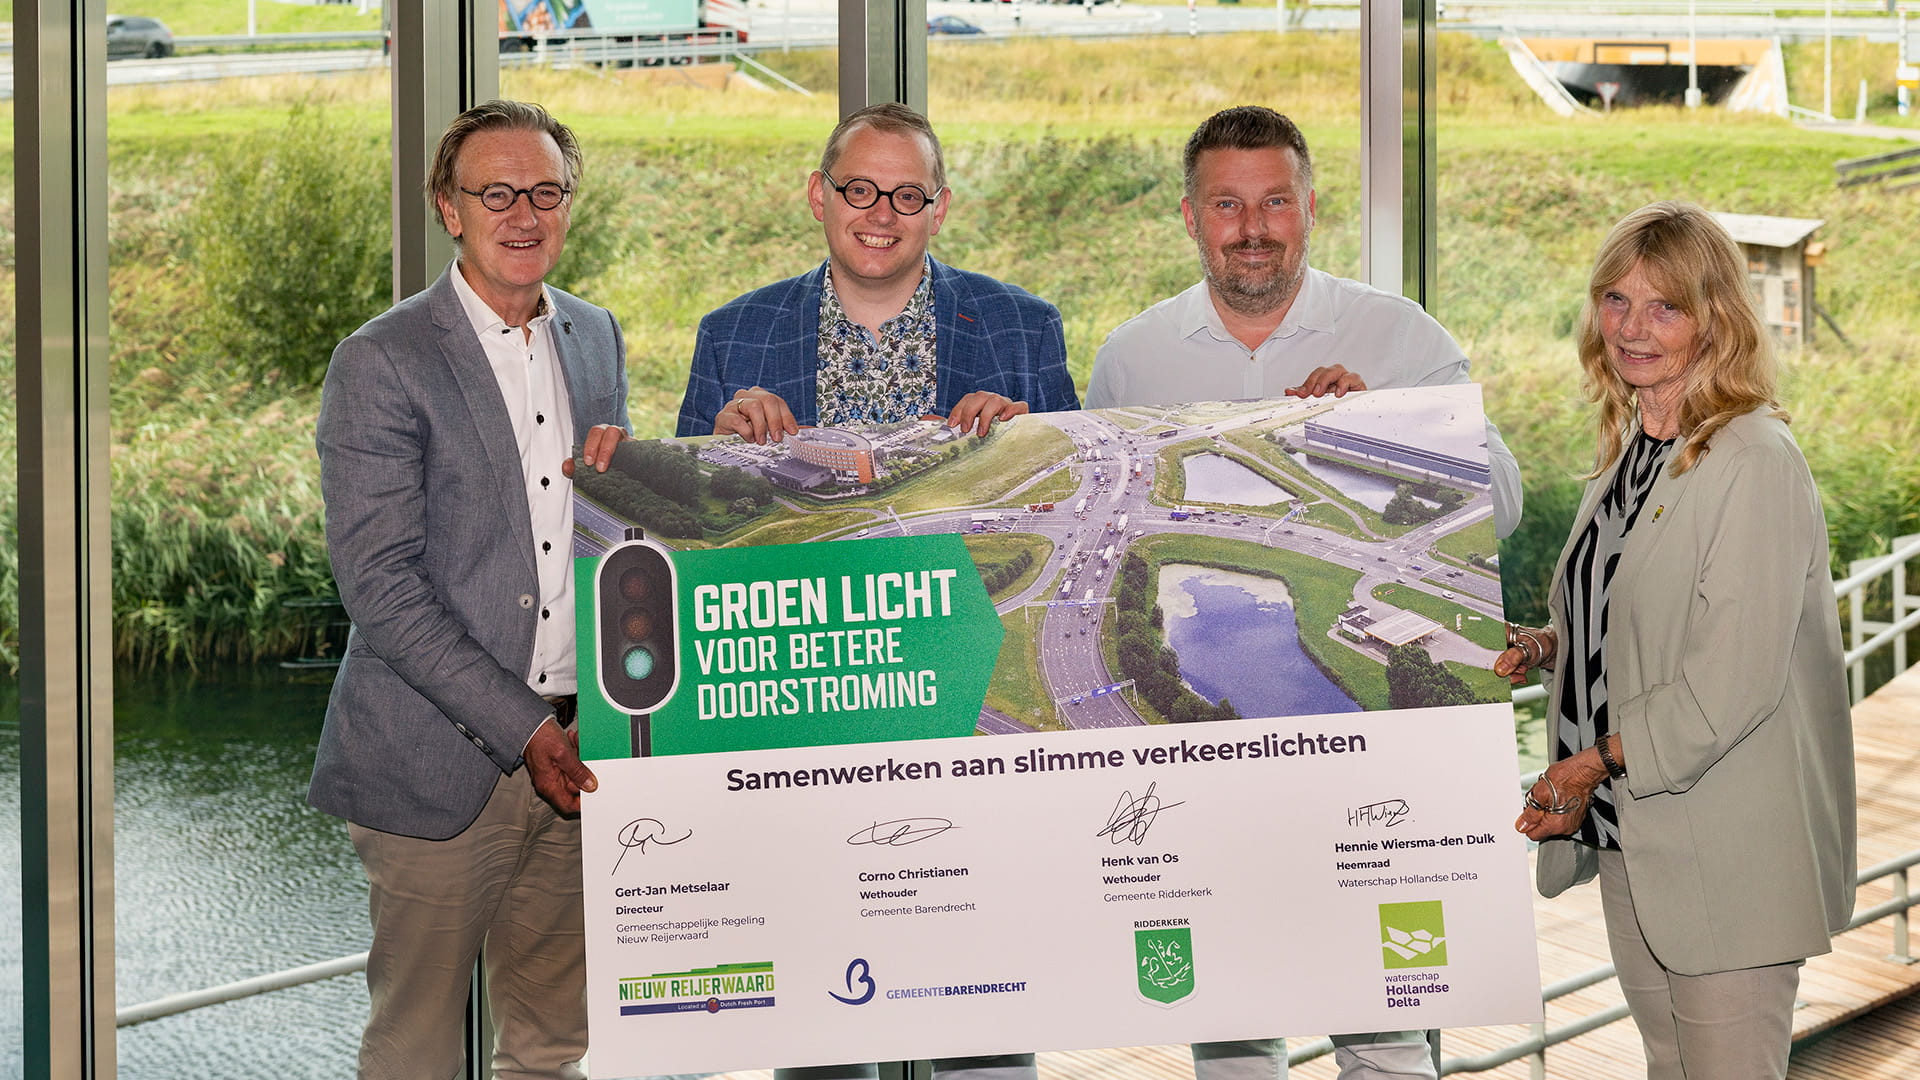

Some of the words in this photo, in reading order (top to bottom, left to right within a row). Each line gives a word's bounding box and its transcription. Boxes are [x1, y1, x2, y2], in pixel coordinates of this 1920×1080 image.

[694, 577, 828, 631] GROEN
[841, 569, 957, 622] LICHT
[694, 635, 777, 674] VOOR
[789, 627, 903, 669] BETERE
[698, 670, 936, 720] DOORSTROMING
[726, 757, 942, 792] Samenwerken
[952, 755, 1005, 777] aan
[1014, 748, 1124, 774] slimme
[1132, 731, 1367, 767] verkeerslichten
[1335, 840, 1378, 853] Hennie
[1381, 835, 1464, 850] Wiersma-den
[1466, 833, 1496, 845] Dulk
[1101, 855, 1134, 867] Henk
[1137, 855, 1159, 865] van
[1162, 853, 1179, 864] Os
[1336, 859, 1391, 870] Heemraad
[858, 871, 896, 882] Corno
[899, 866, 969, 880] Christianen
[1102, 873, 1161, 884] Wethouder
[1338, 876, 1398, 889] Waterschap
[1399, 874, 1449, 885] Hollandse
[1451, 871, 1478, 881] Delta
[615, 885, 667, 898] Gert-Jan
[670, 881, 730, 895] Metselaar
[859, 888, 918, 900] Wethouder
[1103, 891, 1156, 903] Gemeente
[1158, 887, 1212, 899] Ridderkerk
[615, 904, 664, 915] Directeur
[860, 906, 913, 917] Gemeente
[915, 902, 976, 914] Barendrecht
[616, 918, 719, 932] Gemeenschappelijke
[721, 915, 765, 929] Regeling
[1134, 917, 1190, 928] RIDDERKERK
[617, 935, 649, 945] Nieuw
[651, 930, 709, 943] Reijerwaard
[1384, 972, 1440, 983] waterschap
[619, 980, 667, 1001] NIEUW
[671, 974, 775, 998] REIJERWAARD
[1386, 983, 1449, 996] Hollandse
[1387, 997, 1421, 1008] Delta
